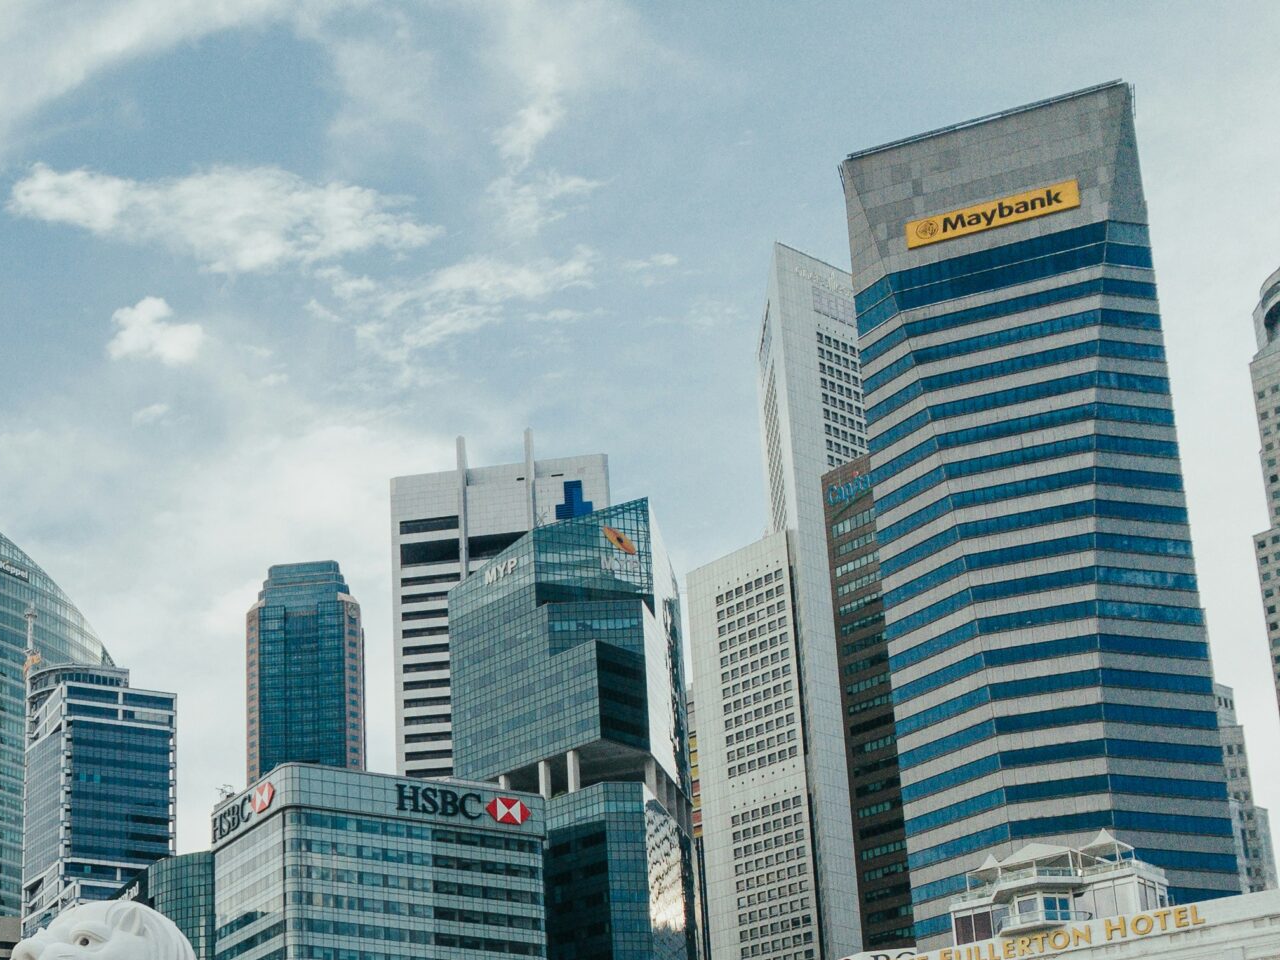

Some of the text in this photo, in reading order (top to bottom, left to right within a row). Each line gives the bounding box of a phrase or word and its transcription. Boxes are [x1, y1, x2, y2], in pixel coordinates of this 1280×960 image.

[941, 189, 1063, 234] Maybank
[0, 560, 29, 579] Keppel
[484, 557, 519, 586] MYP
[211, 794, 253, 844] HSBC
[395, 783, 482, 820] HSBC
[1104, 903, 1206, 941] HOTEL
